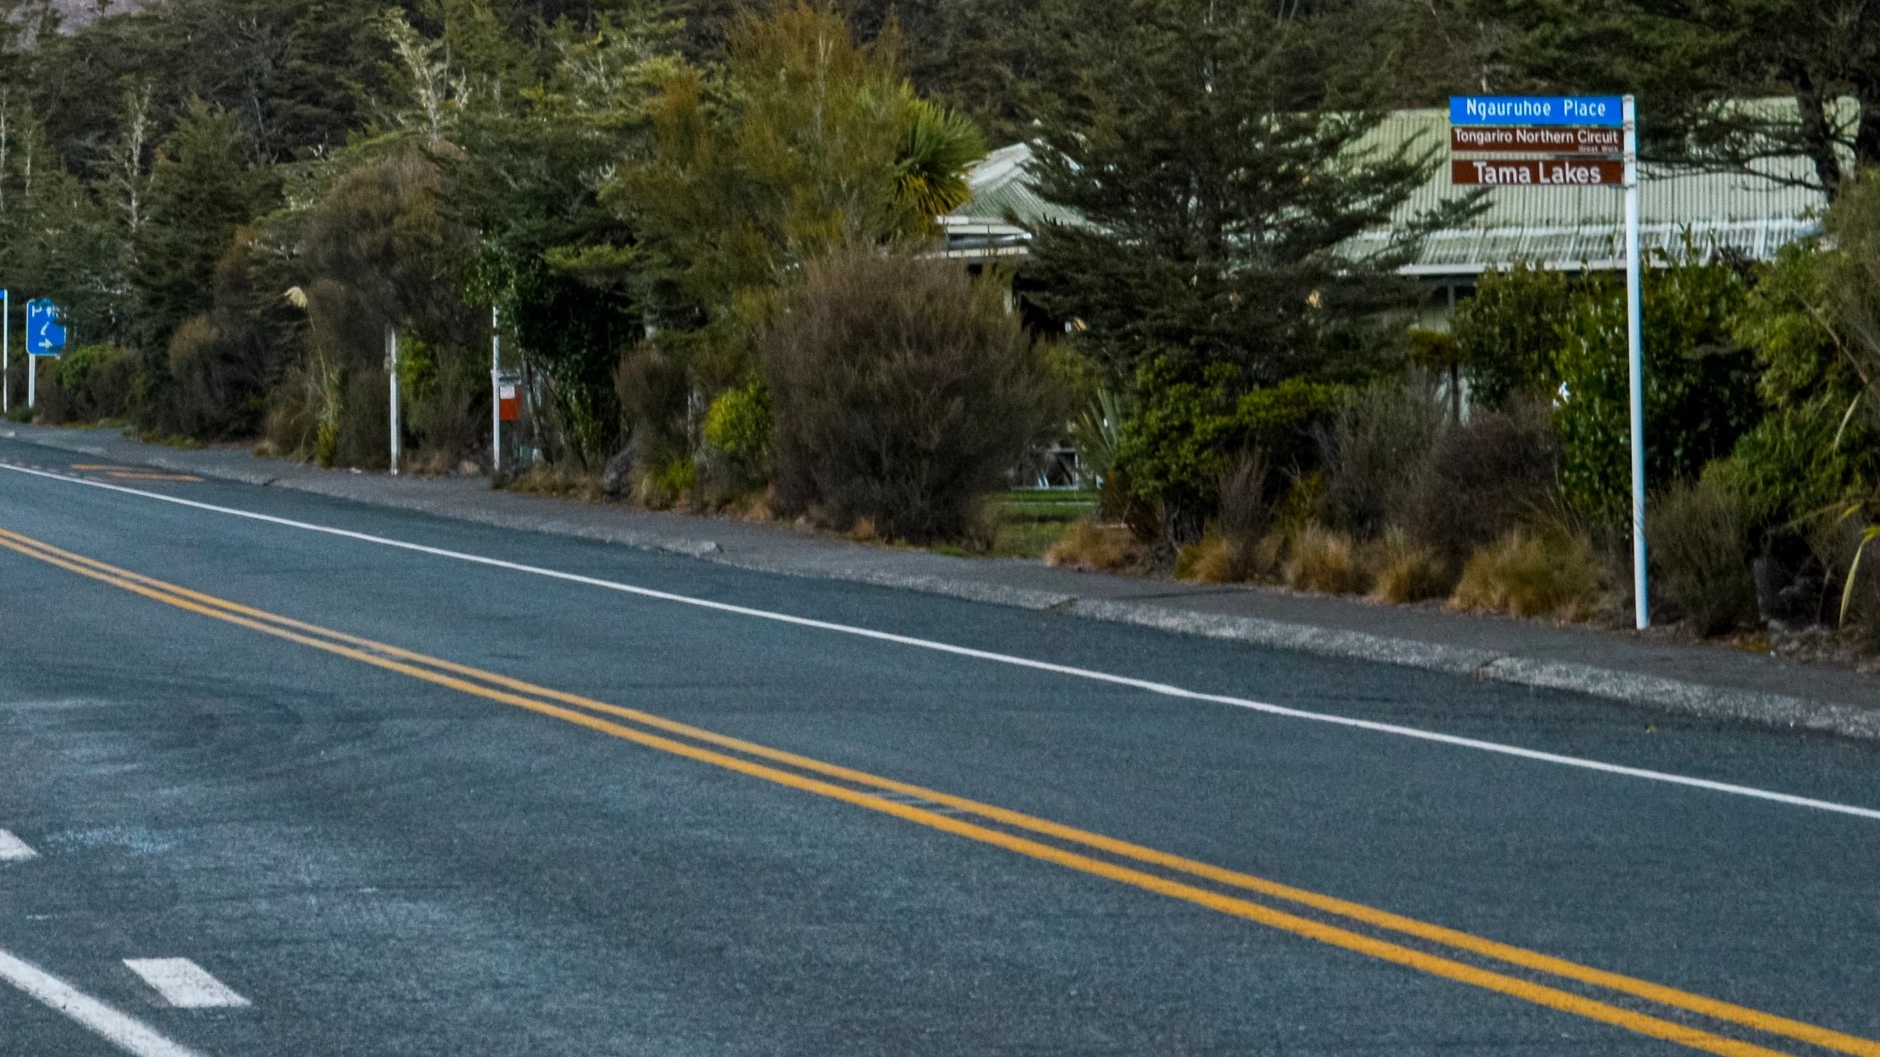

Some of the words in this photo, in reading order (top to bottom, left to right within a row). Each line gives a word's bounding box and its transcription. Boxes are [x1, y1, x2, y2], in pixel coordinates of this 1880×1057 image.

[1466, 98, 1551, 120] Ngauruhoe
[1563, 99, 1606, 117] Place
[1454, 128, 1512, 145] Tongariro
[1516, 129, 1574, 143] Northern
[1577, 129, 1618, 144] Circuit
[1473, 161, 1531, 184] Tama
[1538, 161, 1601, 184] Lakes
